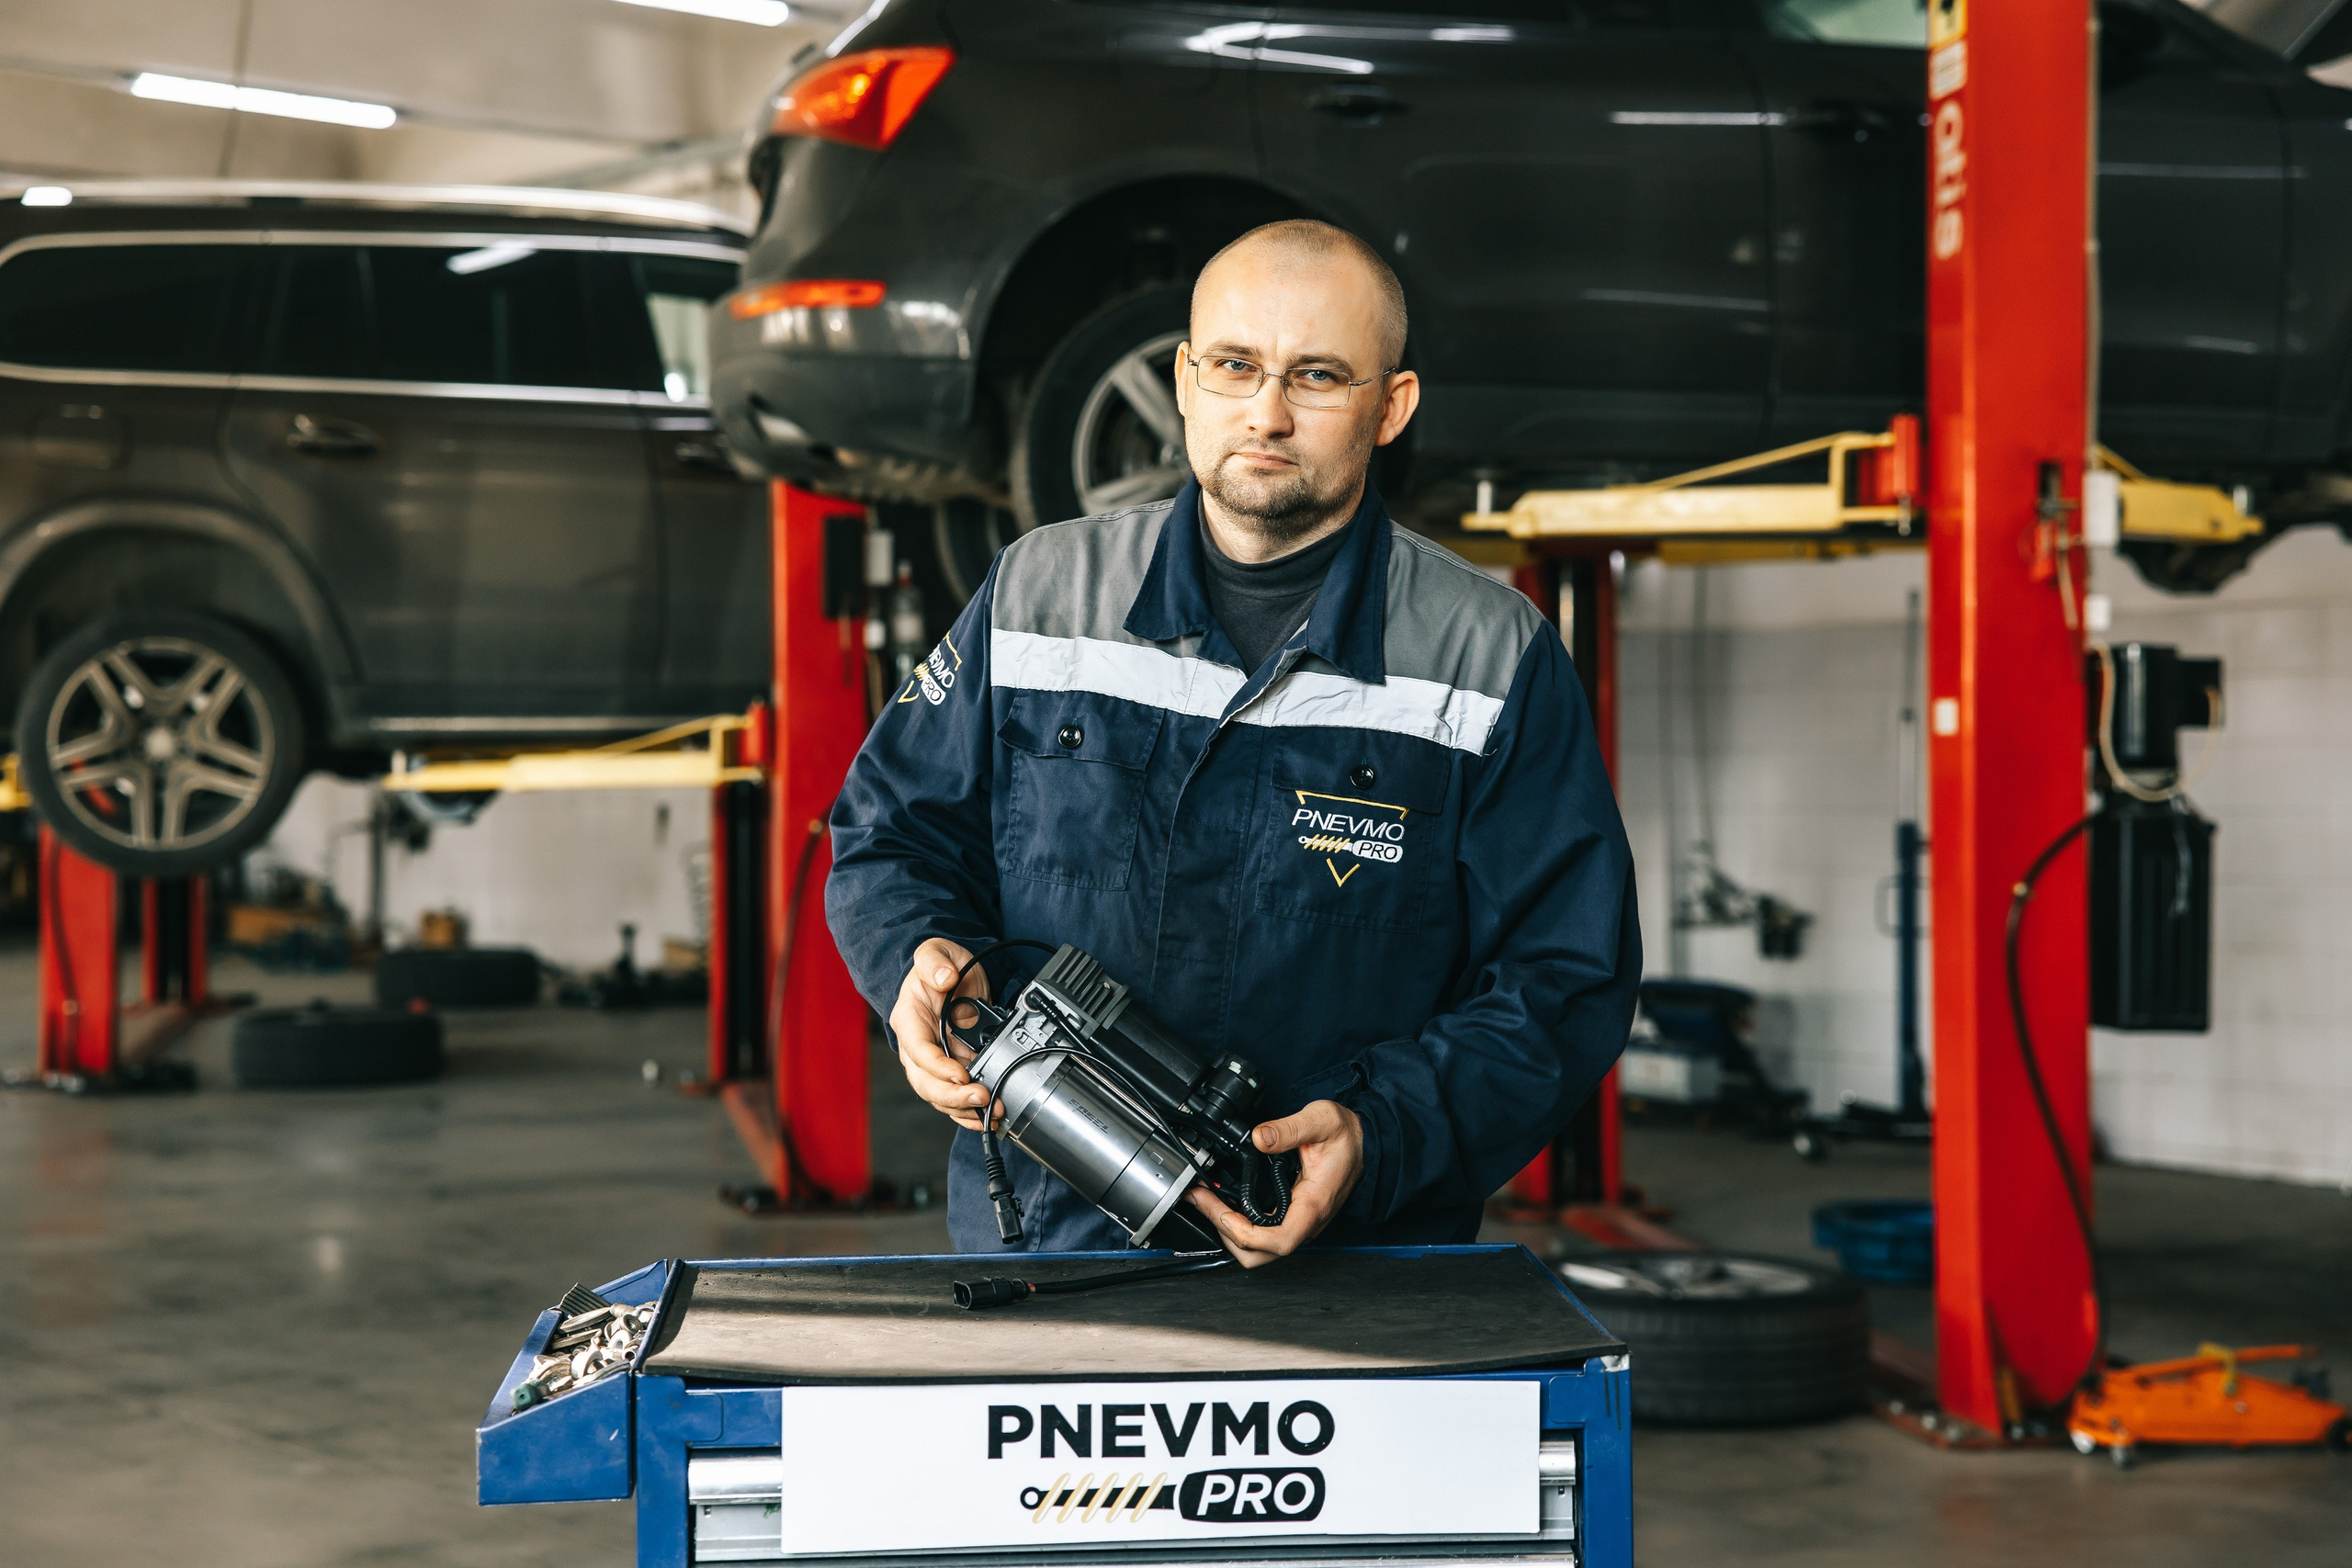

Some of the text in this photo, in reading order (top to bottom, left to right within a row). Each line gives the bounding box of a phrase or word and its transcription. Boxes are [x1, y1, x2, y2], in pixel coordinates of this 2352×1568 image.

[1291, 808, 1406, 841] PNEVMO
[1358, 841, 1397, 861] PRO
[988, 1400, 1335, 1460] PNEVMO
[1196, 1472, 1316, 1517] PRO
